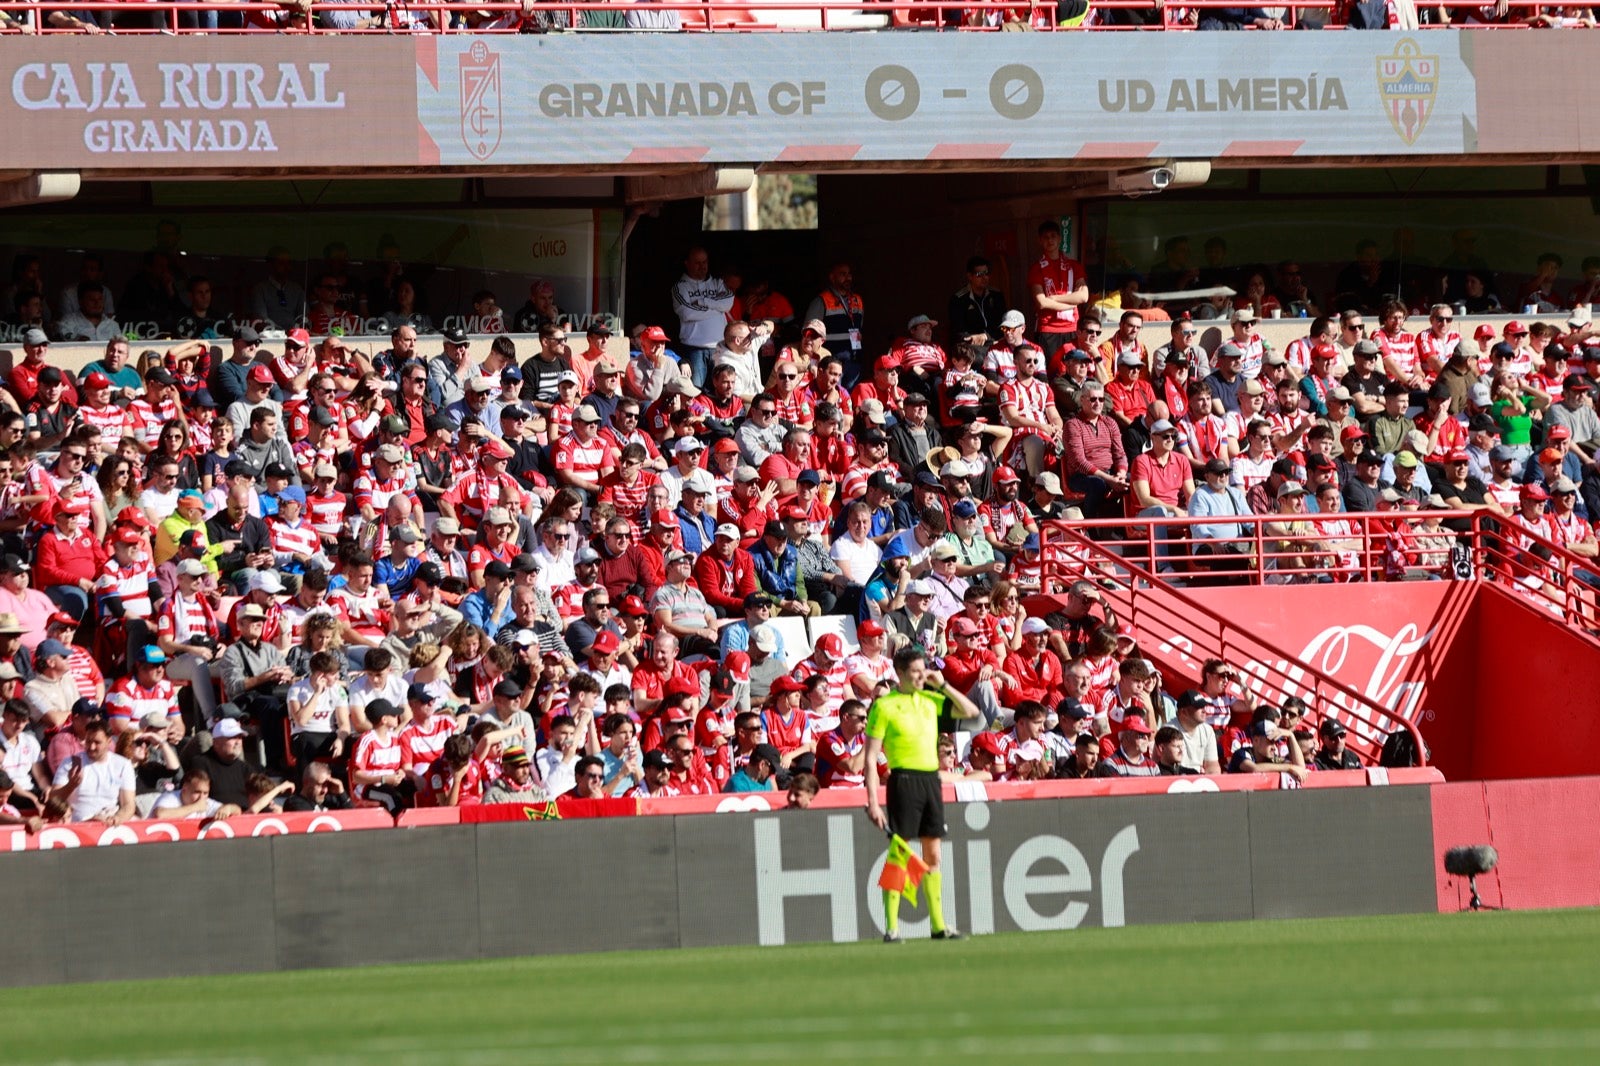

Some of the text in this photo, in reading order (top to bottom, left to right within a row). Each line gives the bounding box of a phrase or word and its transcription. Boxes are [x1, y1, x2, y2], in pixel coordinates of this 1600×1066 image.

[12, 63, 346, 112] CAJA RURAL
[538, 82, 758, 118] GRANADA
[768, 82, 826, 116] CF
[1098, 79, 1155, 112] UD
[1166, 73, 1349, 112] ALMERÍA
[84, 119, 279, 154] GRANADA
[688, 289, 718, 298] adda
[753, 802, 1141, 946] Haier
